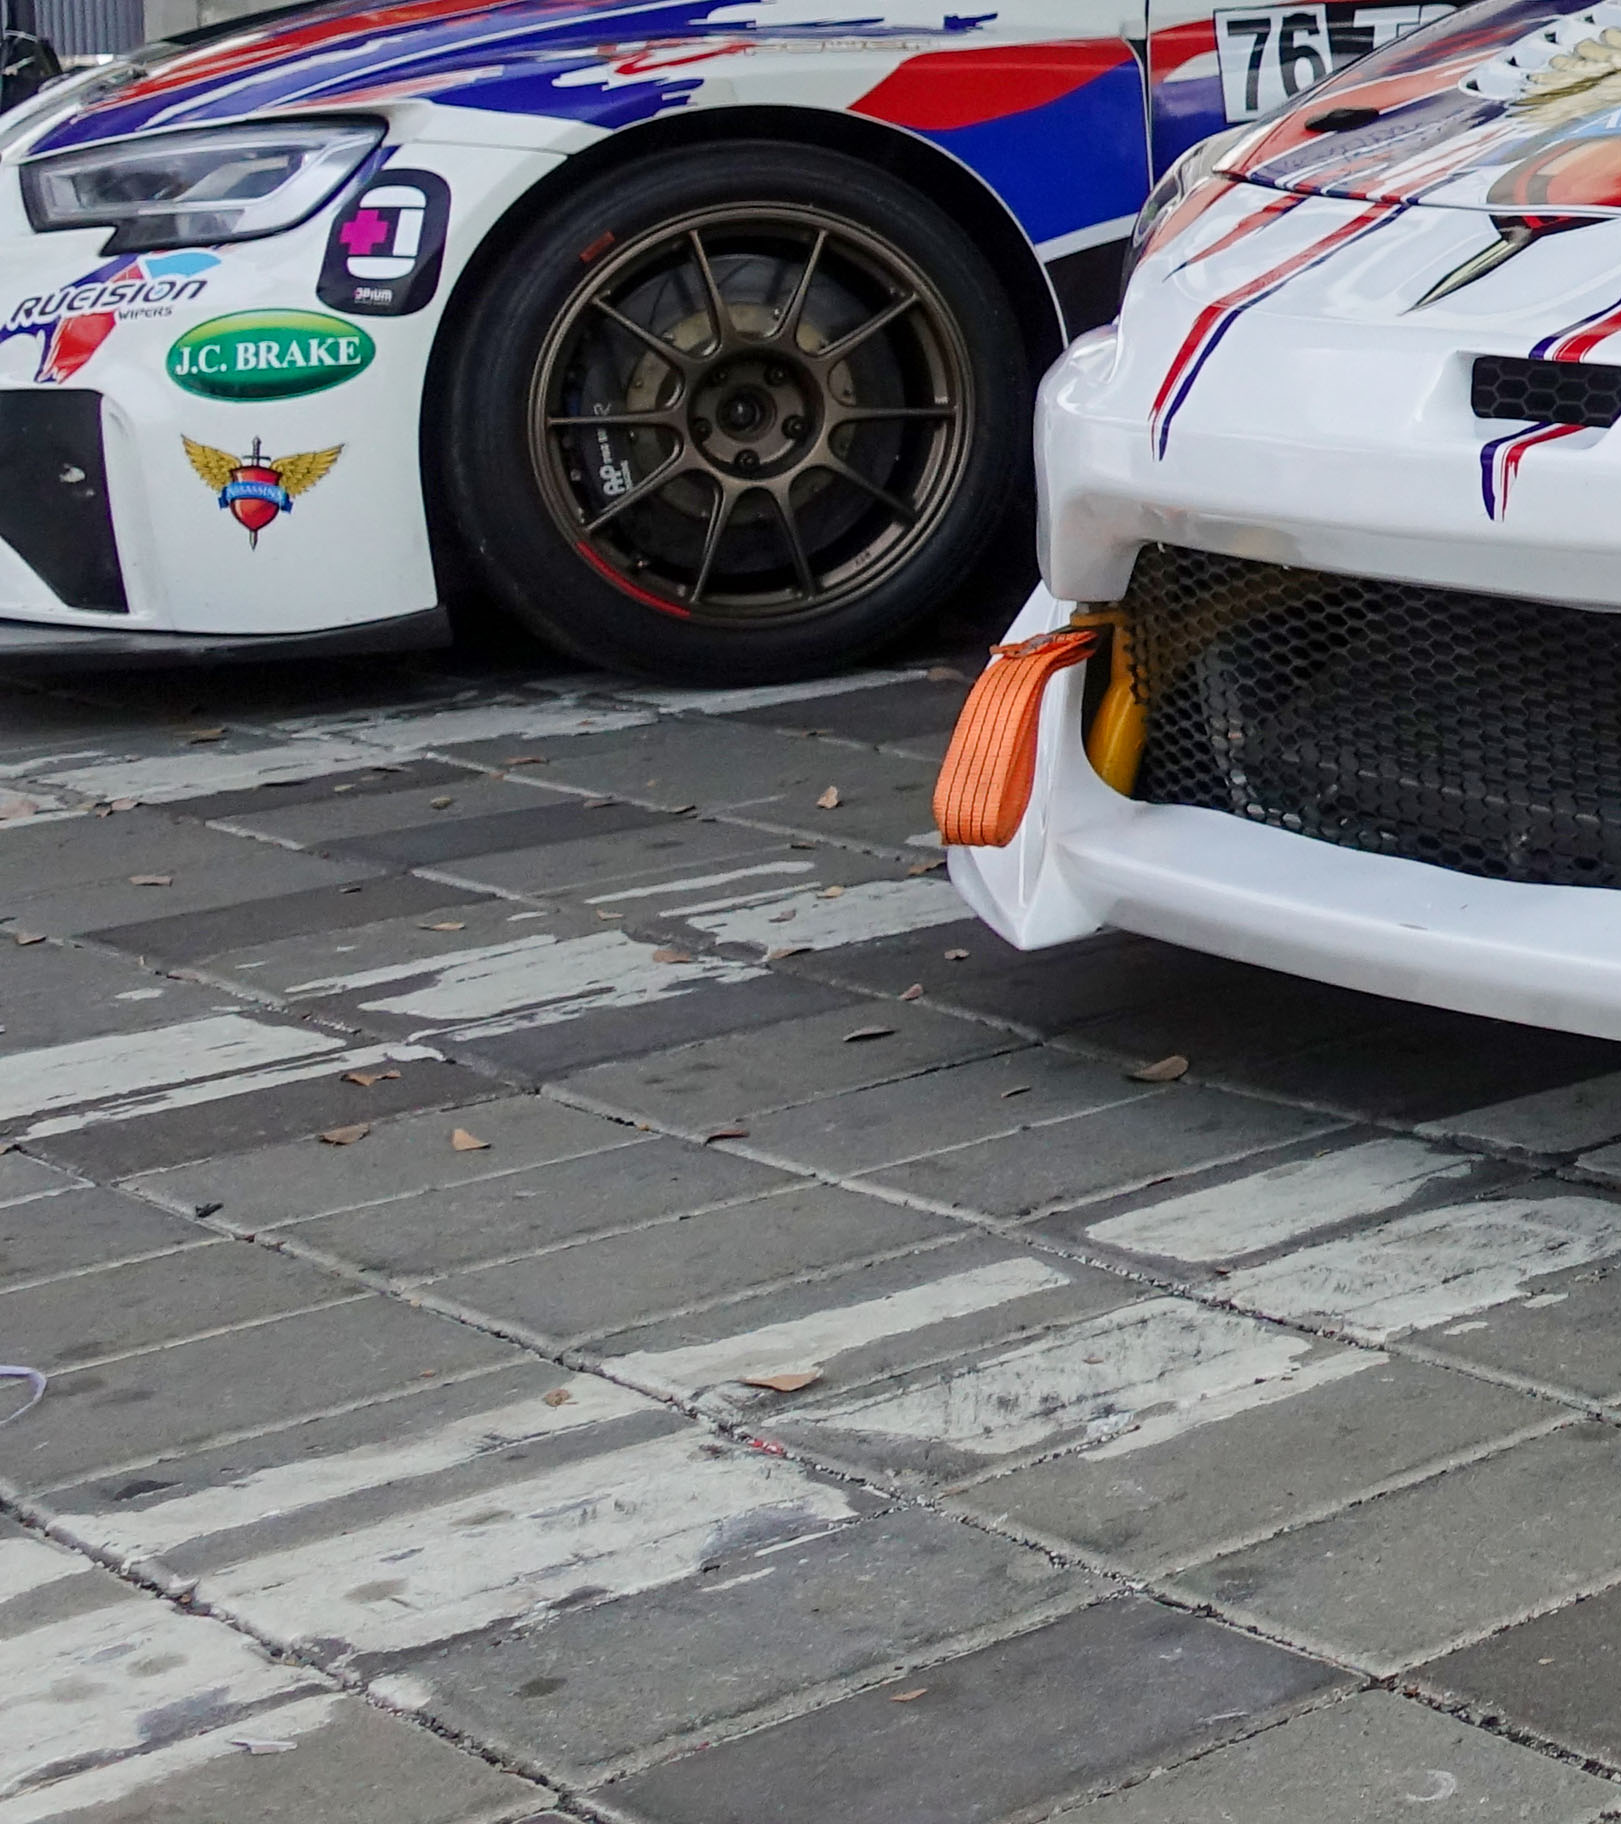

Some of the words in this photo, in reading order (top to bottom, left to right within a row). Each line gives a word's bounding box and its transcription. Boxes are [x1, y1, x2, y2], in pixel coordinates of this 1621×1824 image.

[1227, 12, 1327, 112] 76
[118, 306, 173, 321] WIPERS
[175, 344, 227, 375] J.C.
[234, 336, 362, 371] BRAKE
